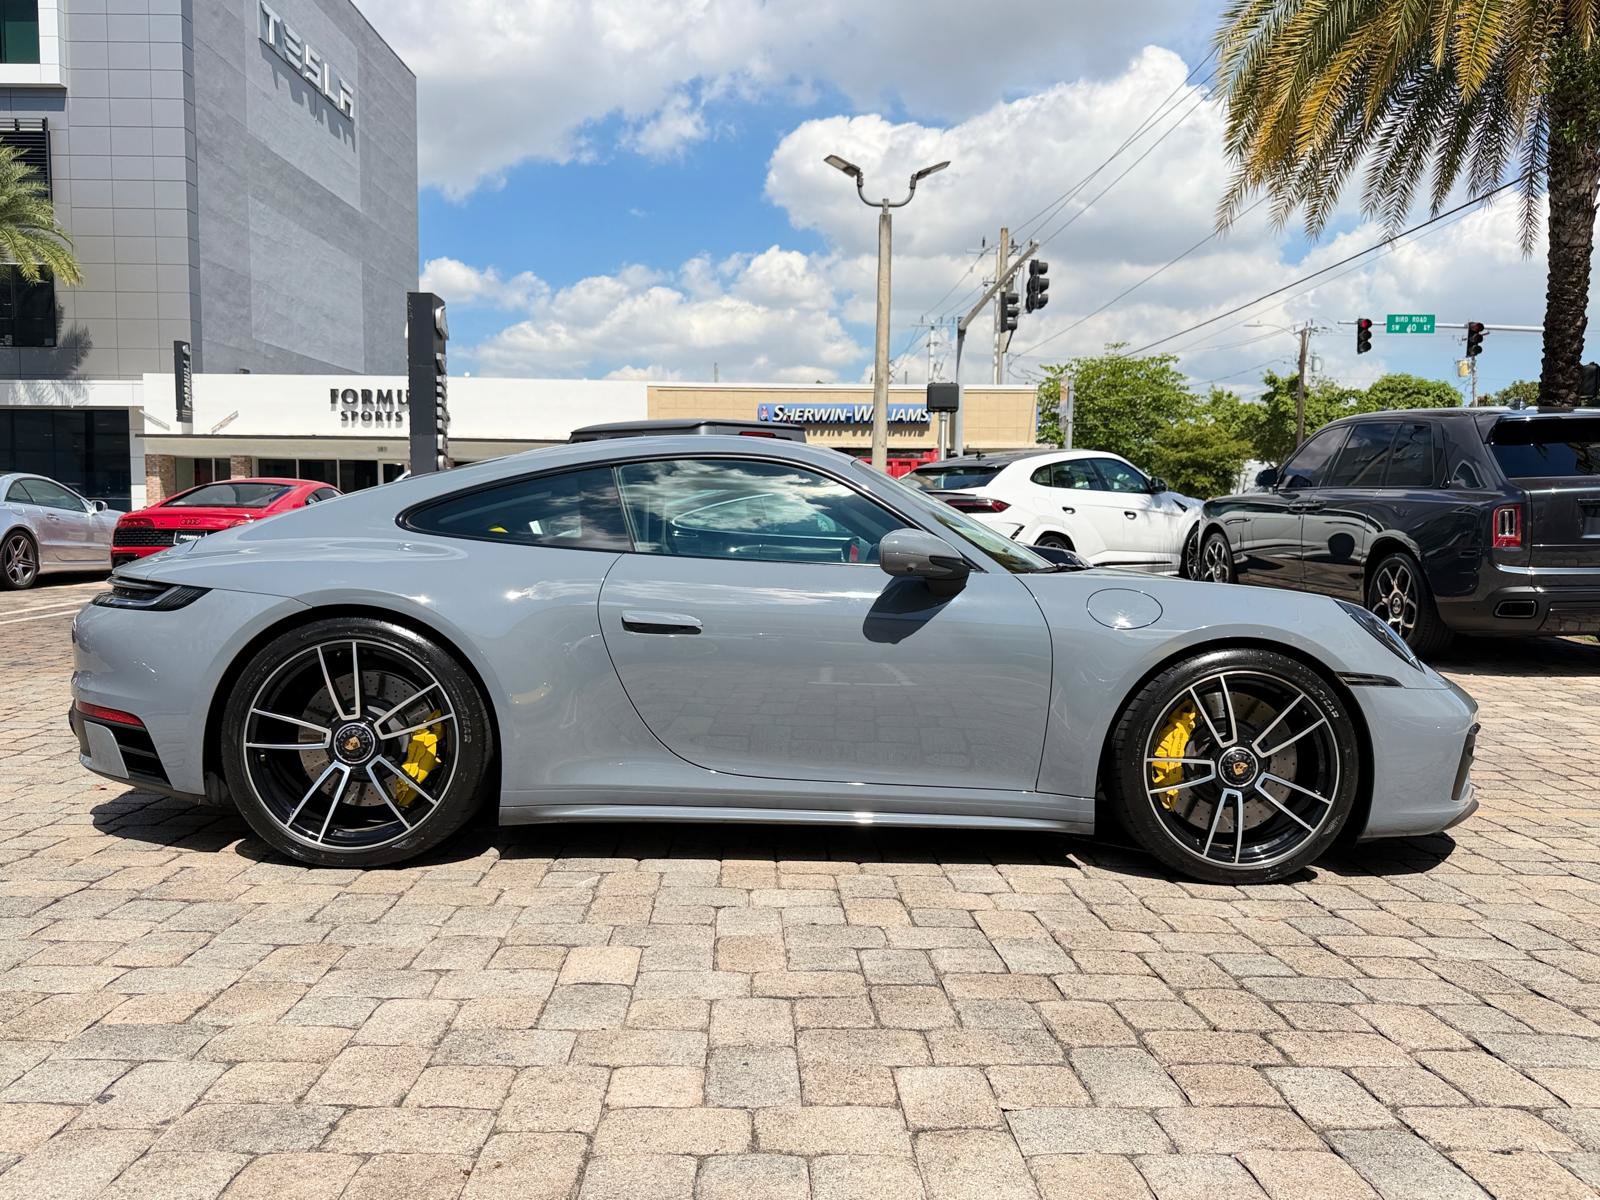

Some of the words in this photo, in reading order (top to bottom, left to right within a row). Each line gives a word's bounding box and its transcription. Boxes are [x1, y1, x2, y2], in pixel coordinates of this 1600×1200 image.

[260, 0, 354, 118] TESLA
[1406, 323, 1417, 333] 40
[330, 388, 410, 405] FORMU
[341, 411, 403, 422] SPORTS
[772, 404, 930, 422] SHERWIN-WIAMS
